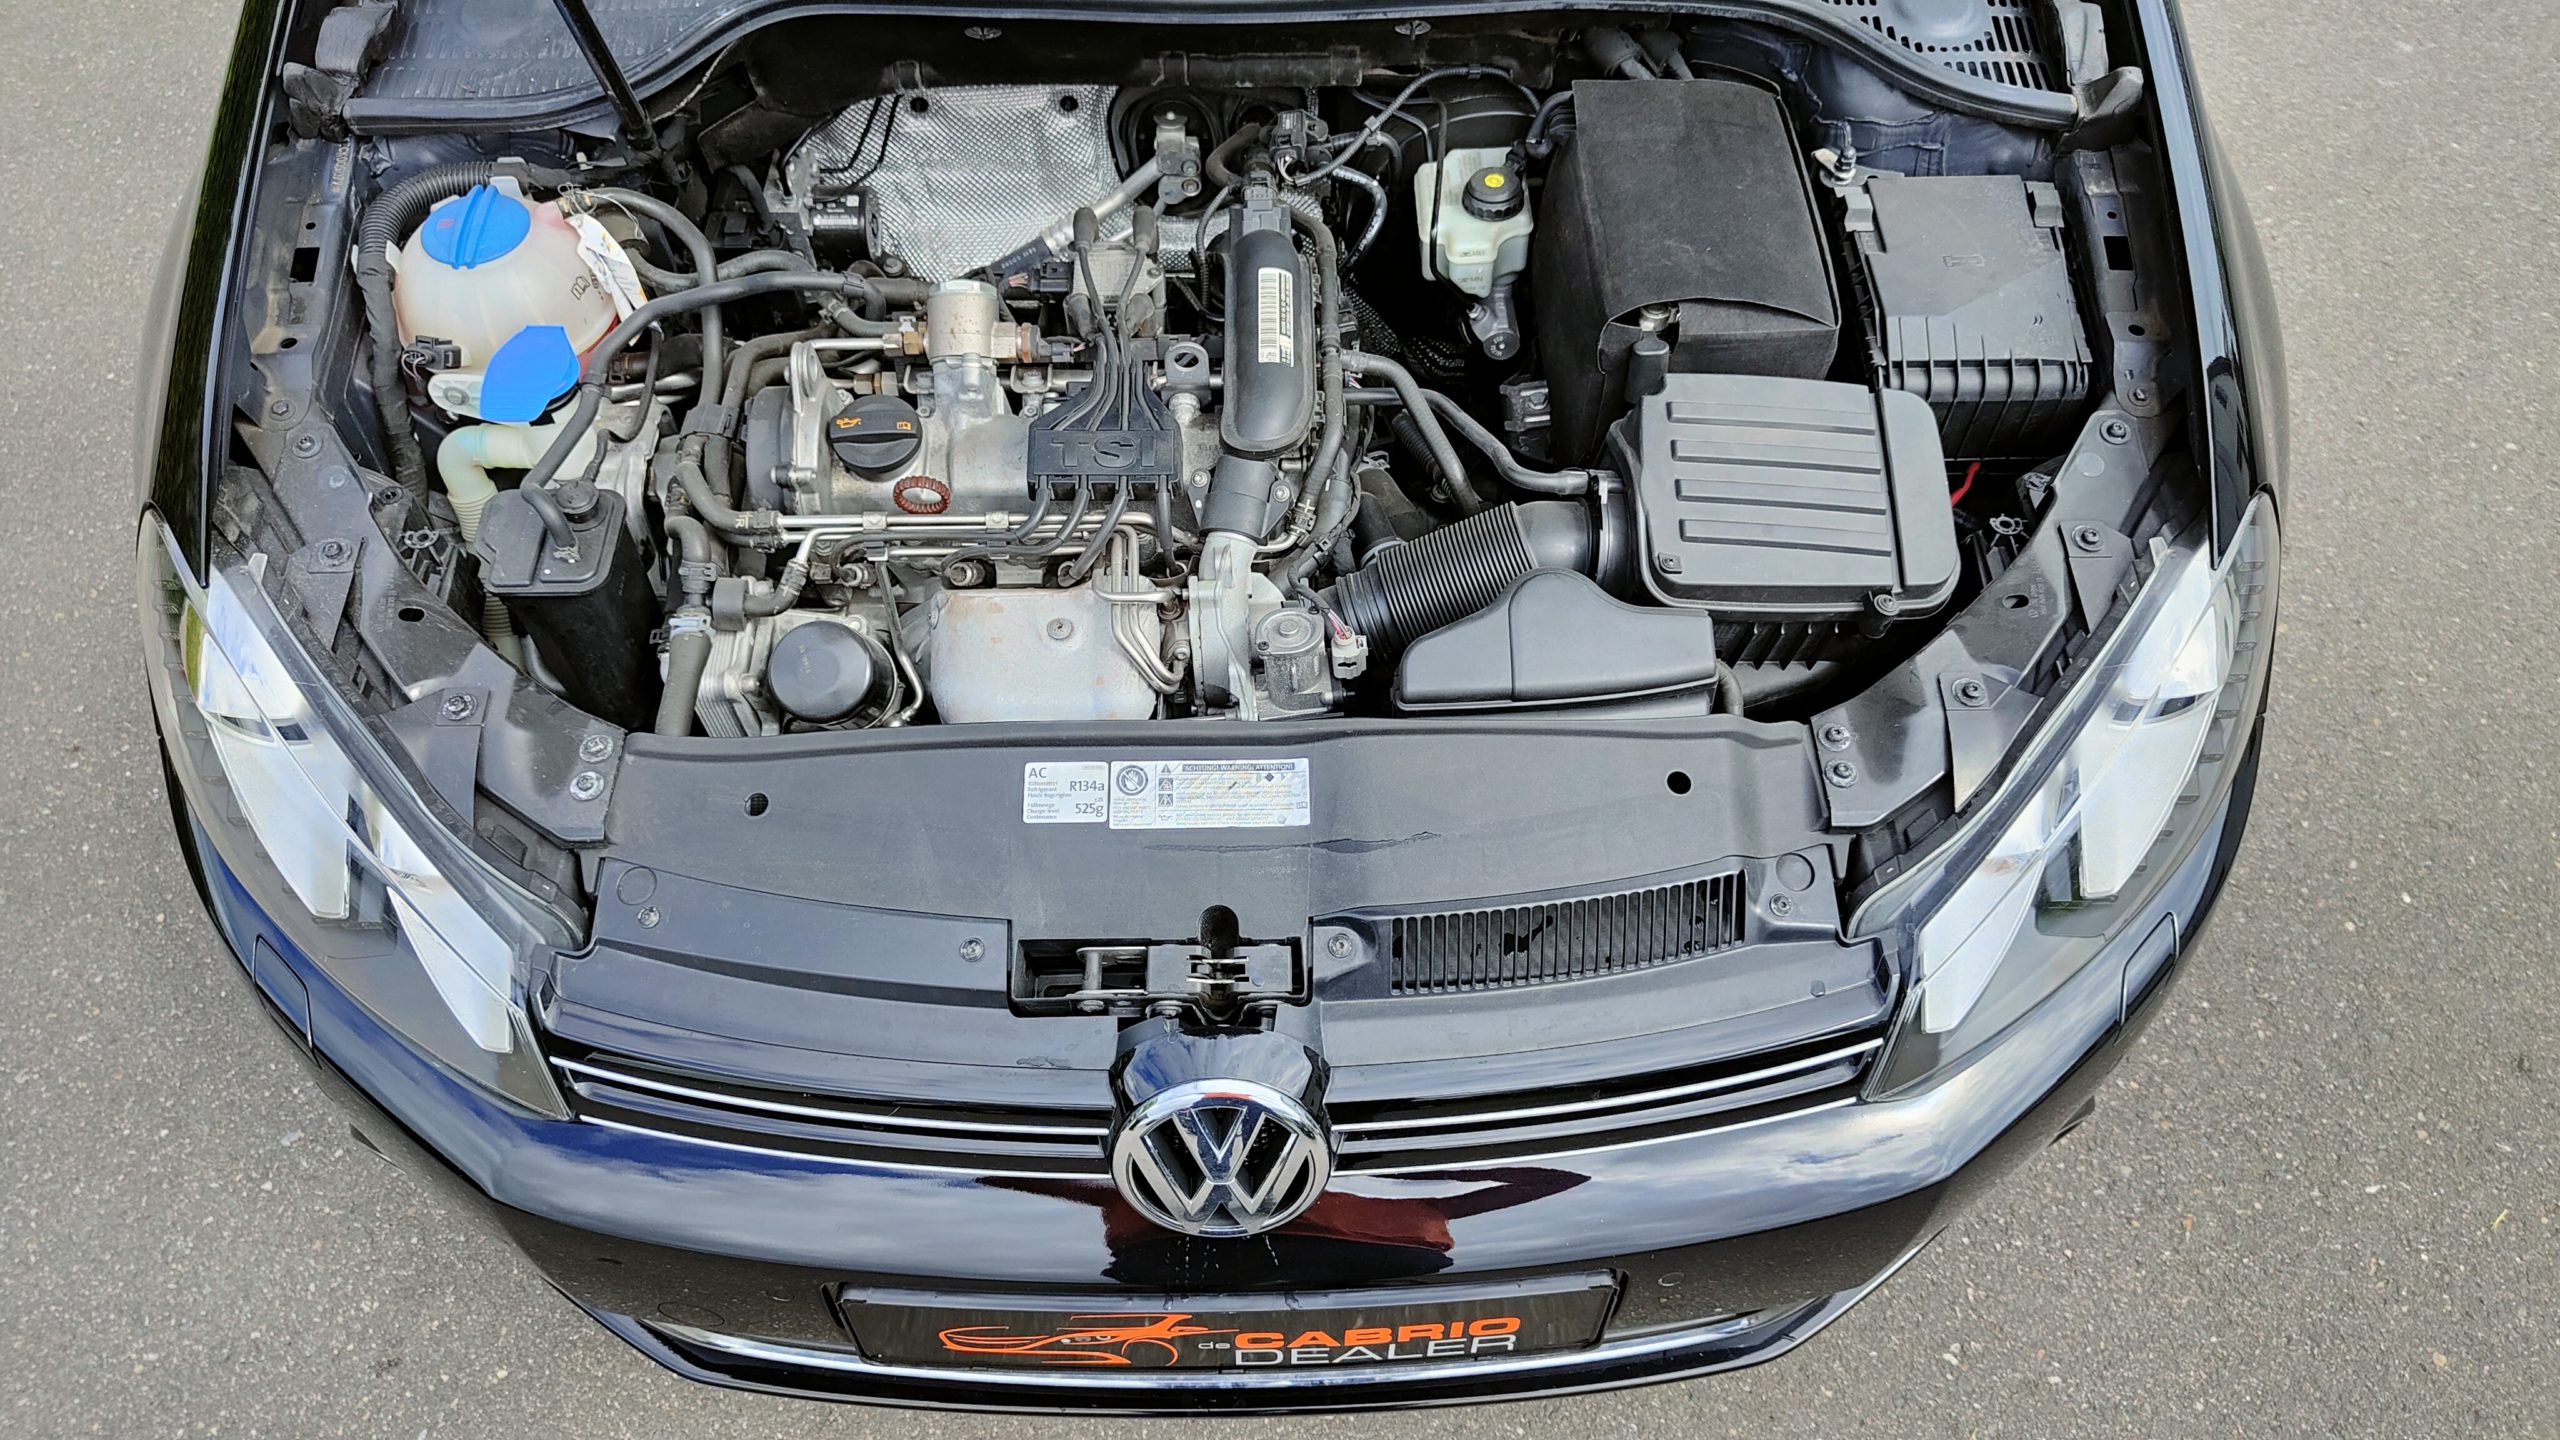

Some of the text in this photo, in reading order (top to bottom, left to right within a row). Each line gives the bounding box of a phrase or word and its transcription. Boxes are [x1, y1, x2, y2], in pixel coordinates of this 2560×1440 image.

[1050, 435, 1156, 468] TSI
[1028, 767, 1047, 778] AC
[1069, 780, 1105, 792] R134a
[1075, 803, 1104, 817] 525g
[1198, 1317, 1521, 1350] de CABRIO
[1235, 1334, 1517, 1366] DEALER
